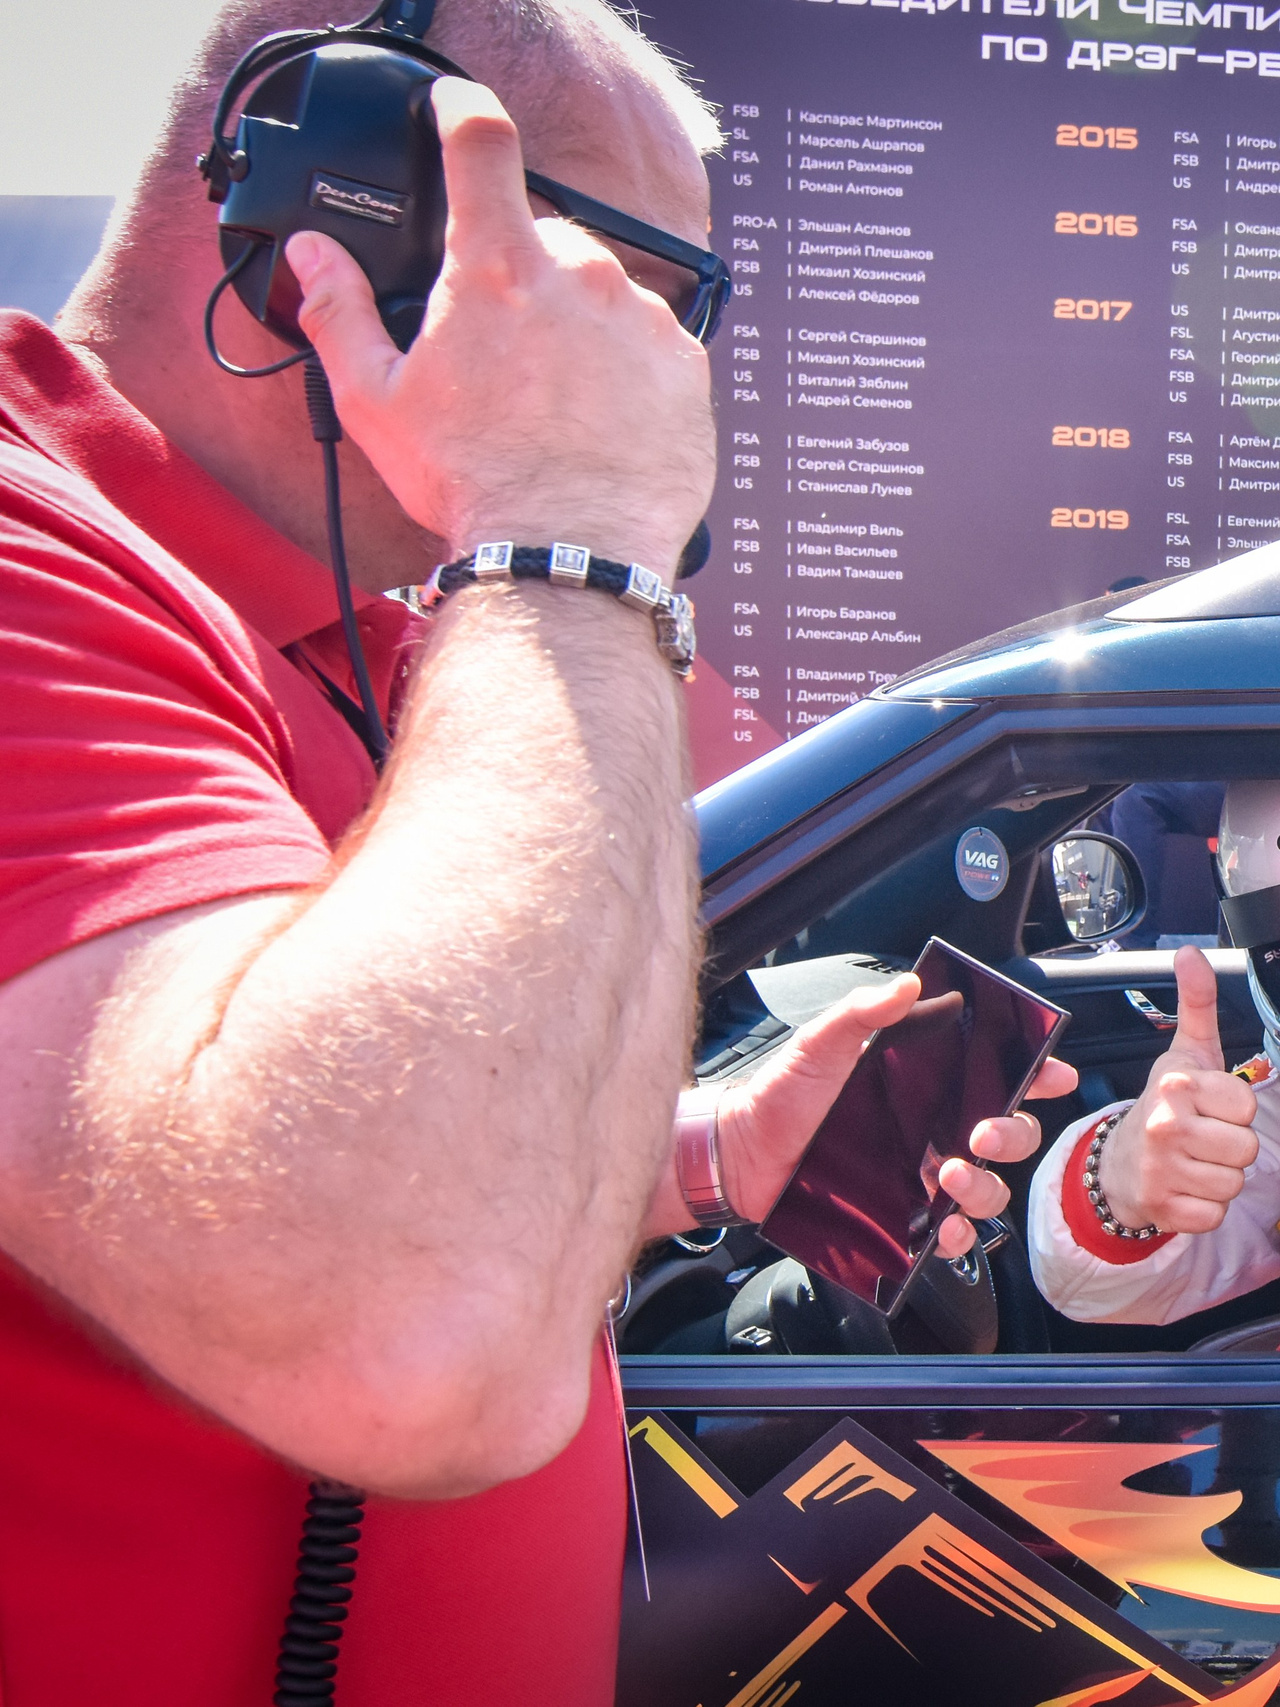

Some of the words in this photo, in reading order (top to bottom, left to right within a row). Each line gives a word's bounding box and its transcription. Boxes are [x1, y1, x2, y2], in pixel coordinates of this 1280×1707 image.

[982, 35, 1047, 62] ПО
[800, 111, 863, 127] Каспарас
[867, 115, 942, 130] Мартинсон
[733, 127, 750, 140] SL
[800, 134, 860, 149] Марсель
[862, 138, 925, 152] Ашрапов
[1057, 125, 1137, 149] 2015
[1237, 135, 1277, 150] Игорь
[799, 156, 844, 170] Данил
[847, 159, 913, 174] Рахманов
[1174, 154, 1199, 166] FSB
[800, 179, 843, 193] Роман
[846, 183, 903, 197] Антонов
[733, 215, 777, 229] PRO-A
[798, 219, 851, 233] Эльшан
[853, 222, 911, 236] Асланов
[1056, 212, 1138, 236] 2016
[798, 241, 861, 257] Дмитрий
[865, 245, 934, 260] Плешаков
[1172, 240, 1197, 253] FSB
[733, 260, 760, 273] FSB
[798, 264, 850, 278] Михаил
[853, 267, 925, 282] Хозинский
[798, 287, 856, 301] Алексей
[858, 290, 919, 306] Фёдоров
[1054, 298, 1132, 321] 2017
[1171, 304, 1189, 316] US
[798, 329, 847, 343] Сергей
[850, 332, 926, 346] Старшинов
[734, 348, 760, 360] FSB
[798, 351, 850, 365] Михаил
[853, 354, 925, 368] Хозинский
[798, 373, 856, 387] Виталий
[859, 376, 908, 390] Зяблин
[1169, 371, 1194, 383] FSB
[734, 389, 760, 401] FSA
[798, 393, 850, 407] Андрей
[853, 395, 912, 409] Семенов
[797, 435, 853, 449] Евгений
[856, 438, 909, 453] Забузов
[1053, 426, 1130, 448] 2018
[1168, 431, 1193, 443] FSA
[1230, 435, 1270, 448] Артём
[734, 455, 760, 467] FSB
[797, 458, 845, 472] Сергей
[848, 460, 924, 474] Старшинов
[1229, 457, 1279, 469] Максим
[798, 479, 868, 494] Станислав
[870, 483, 912, 497] Лунев
[1051, 508, 1129, 529] 2019
[1167, 512, 1190, 524] FSL
[1227, 515, 1280, 528] Евгений
[797, 521, 867, 537] Владимир
[870, 524, 903, 536] Виль
[734, 540, 760, 552] FSB
[797, 543, 831, 555] Иван
[834, 544, 898, 558] Васильев
[1166, 556, 1190, 568] FSB
[797, 564, 841, 578] Вадим
[843, 566, 903, 580] Тамашев
[734, 602, 760, 615] FSA
[797, 606, 837, 620] Игорь
[840, 607, 896, 621] Баранов
[796, 628, 868, 643] Александр
[871, 630, 921, 643] Альбин
[796, 668, 865, 684] Владимир
[734, 687, 760, 699] FSB
[734, 709, 758, 721] FSL
[734, 731, 752, 742] US
[965, 850, 999, 870] VAG
[964, 870, 999, 882] POWER
